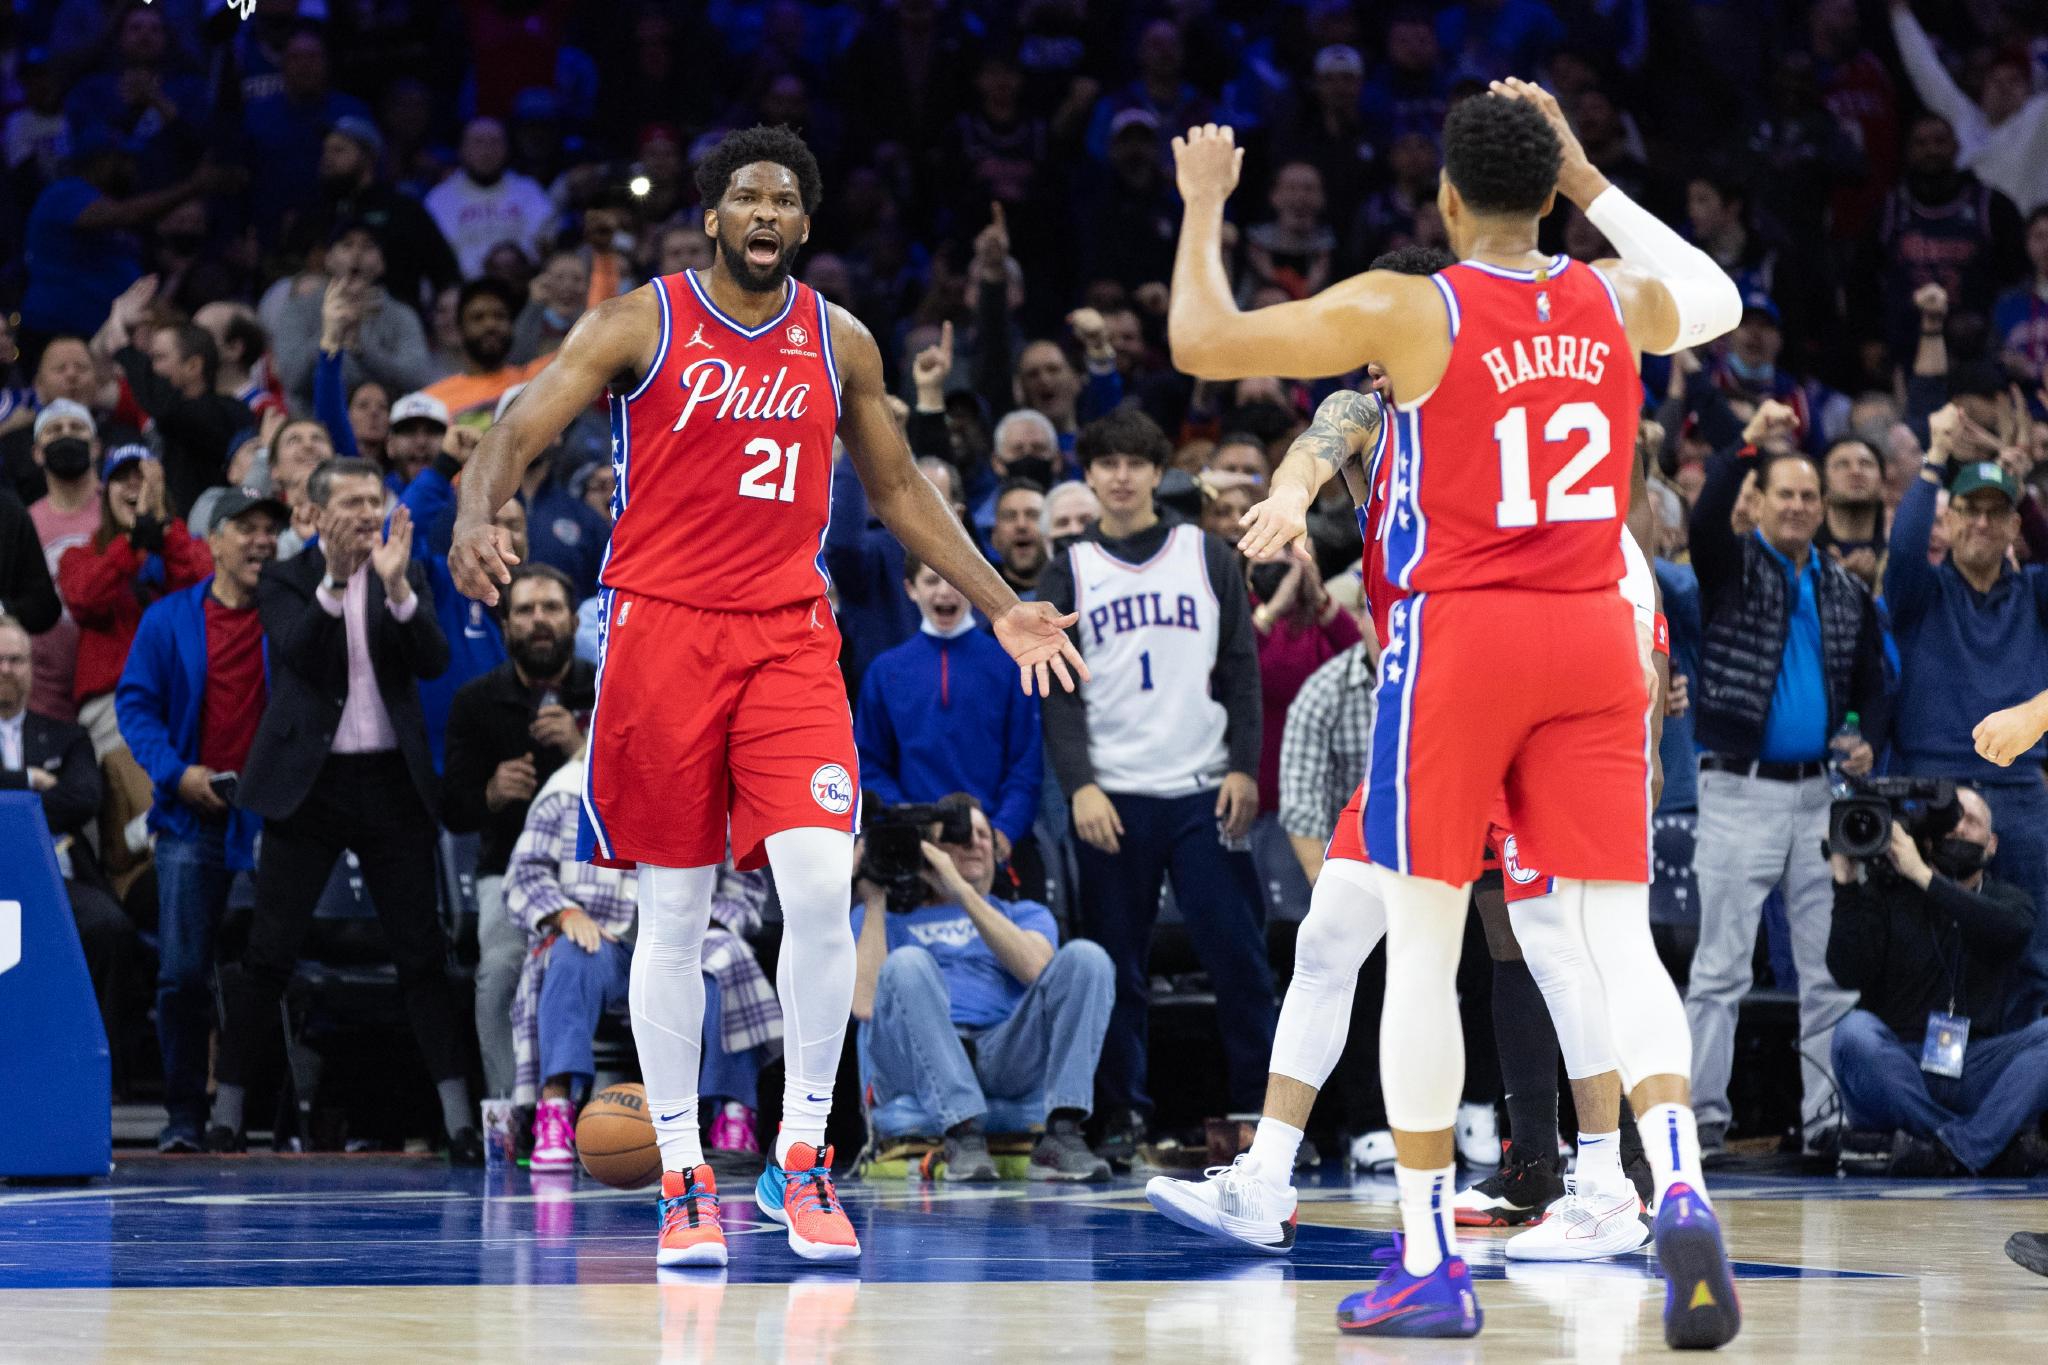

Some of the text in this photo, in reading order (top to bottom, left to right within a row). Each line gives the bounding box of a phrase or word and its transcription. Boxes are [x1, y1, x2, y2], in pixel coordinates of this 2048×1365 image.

[780, 348, 818, 358] crypto.com
[1482, 334, 1611, 394] HARRIS
[673, 358, 811, 432] Phila
[738, 437, 802, 503] 21
[1494, 401, 1617, 528] 12
[1089, 592, 1200, 645] PHILA
[1138, 649, 1154, 692] 1
